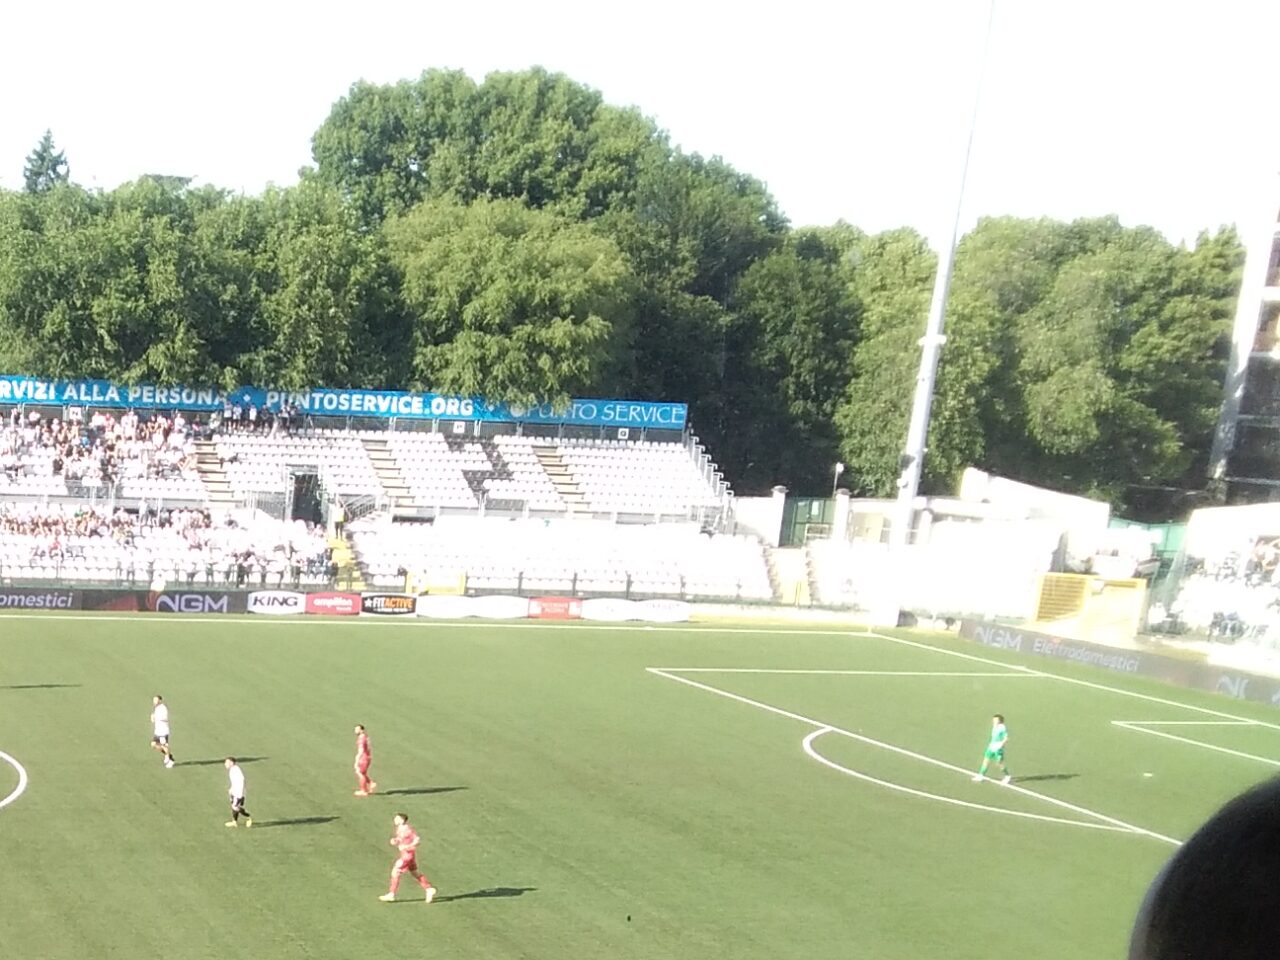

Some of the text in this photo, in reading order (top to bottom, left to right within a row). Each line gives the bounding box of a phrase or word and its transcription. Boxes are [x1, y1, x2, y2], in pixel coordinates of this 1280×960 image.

[63, 383, 121, 402] ALLA
[527, 401, 687, 424] PUTO SERVICE
[156, 593, 228, 613] NGM
[252, 592, 299, 606] KING
[1033, 638, 1141, 672] Elettrodomestici
